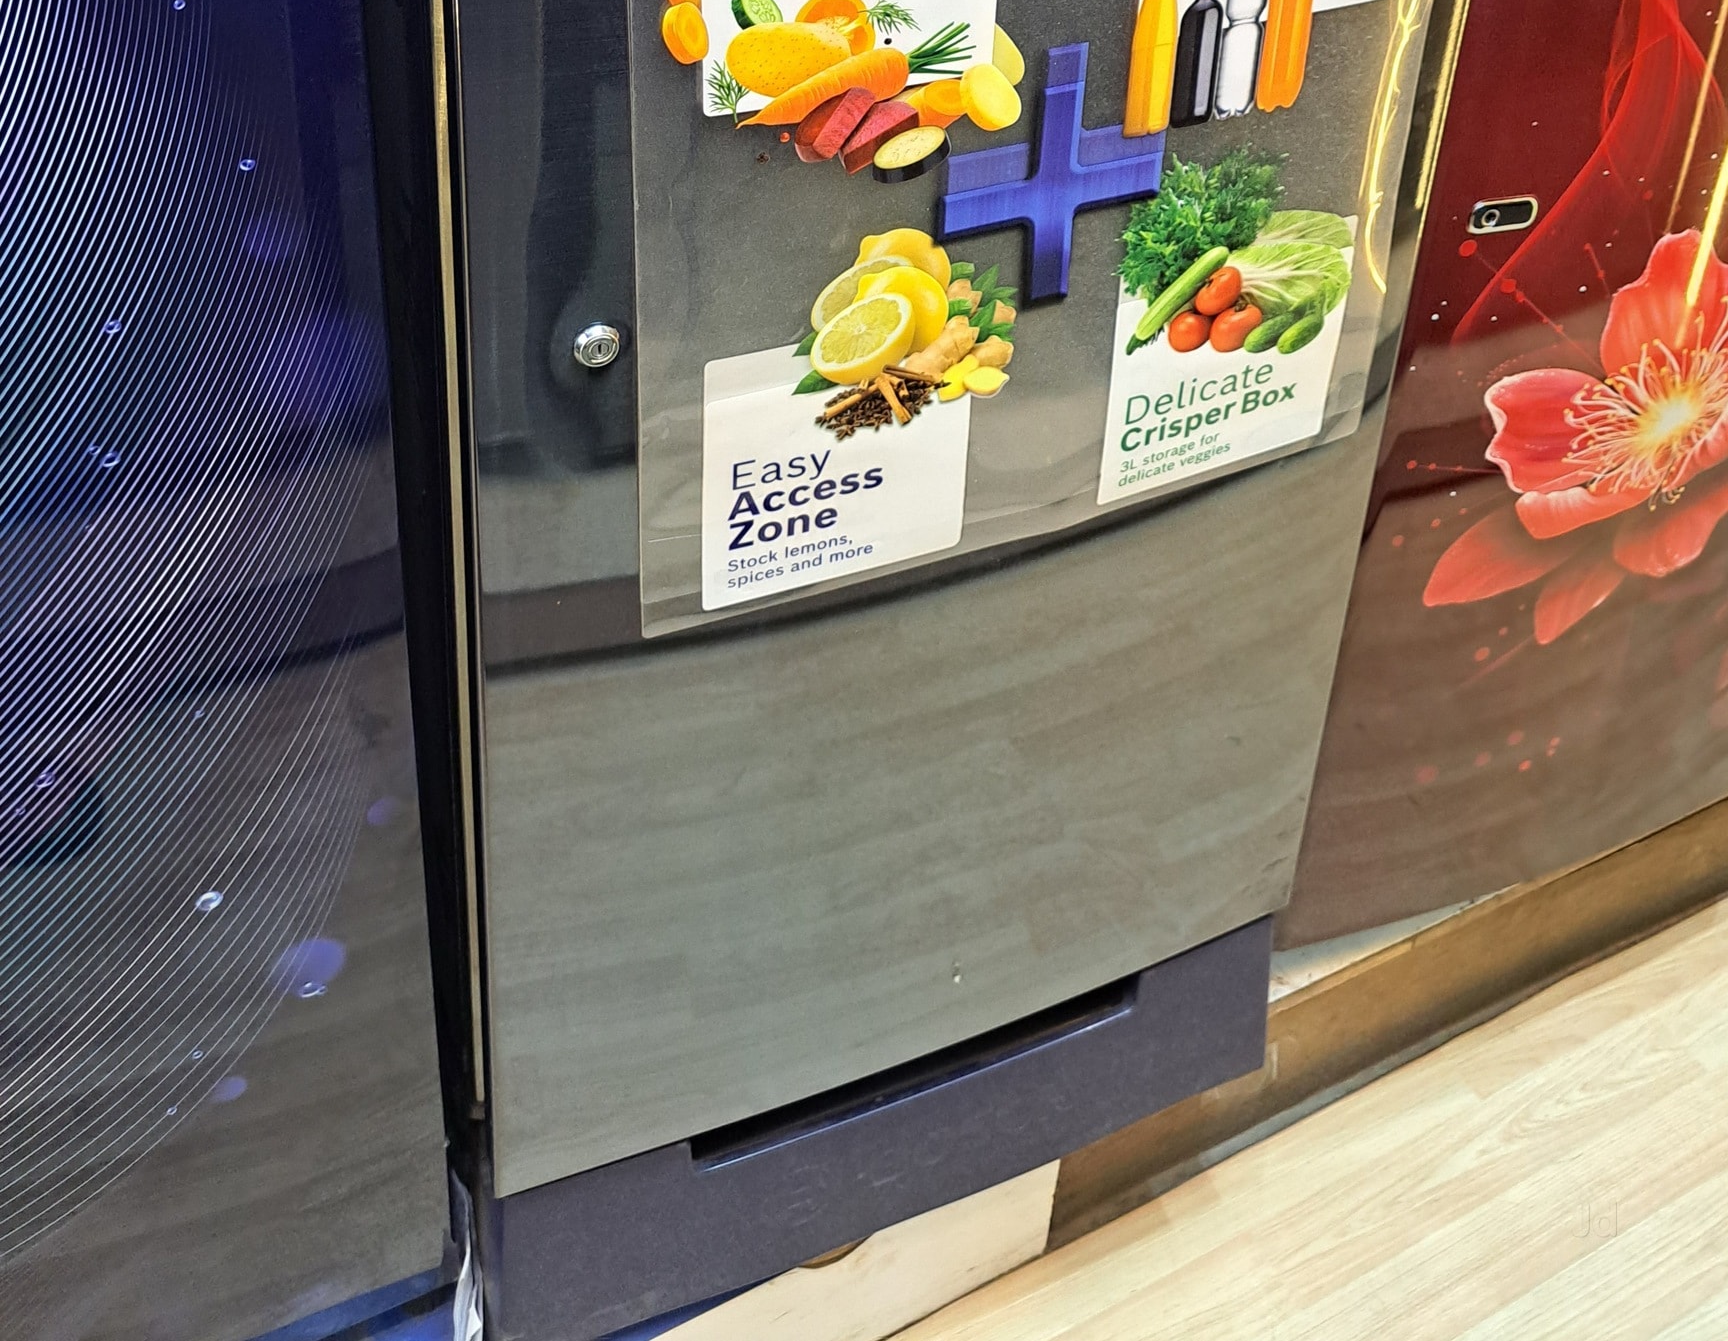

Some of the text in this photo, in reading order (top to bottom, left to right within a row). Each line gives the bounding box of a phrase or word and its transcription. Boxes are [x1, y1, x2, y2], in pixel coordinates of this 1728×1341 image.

[1124, 363, 1274, 426] Delicate
[732, 449, 831, 491] Easy
[1118, 441, 1231, 487] delicate veggies
[1119, 432, 1220, 473] 3L storage for
[727, 467, 884, 521] Access
[727, 507, 838, 551] Zone
[727, 535, 853, 573] Stock lemons,
[727, 543, 873, 589] spices and more
